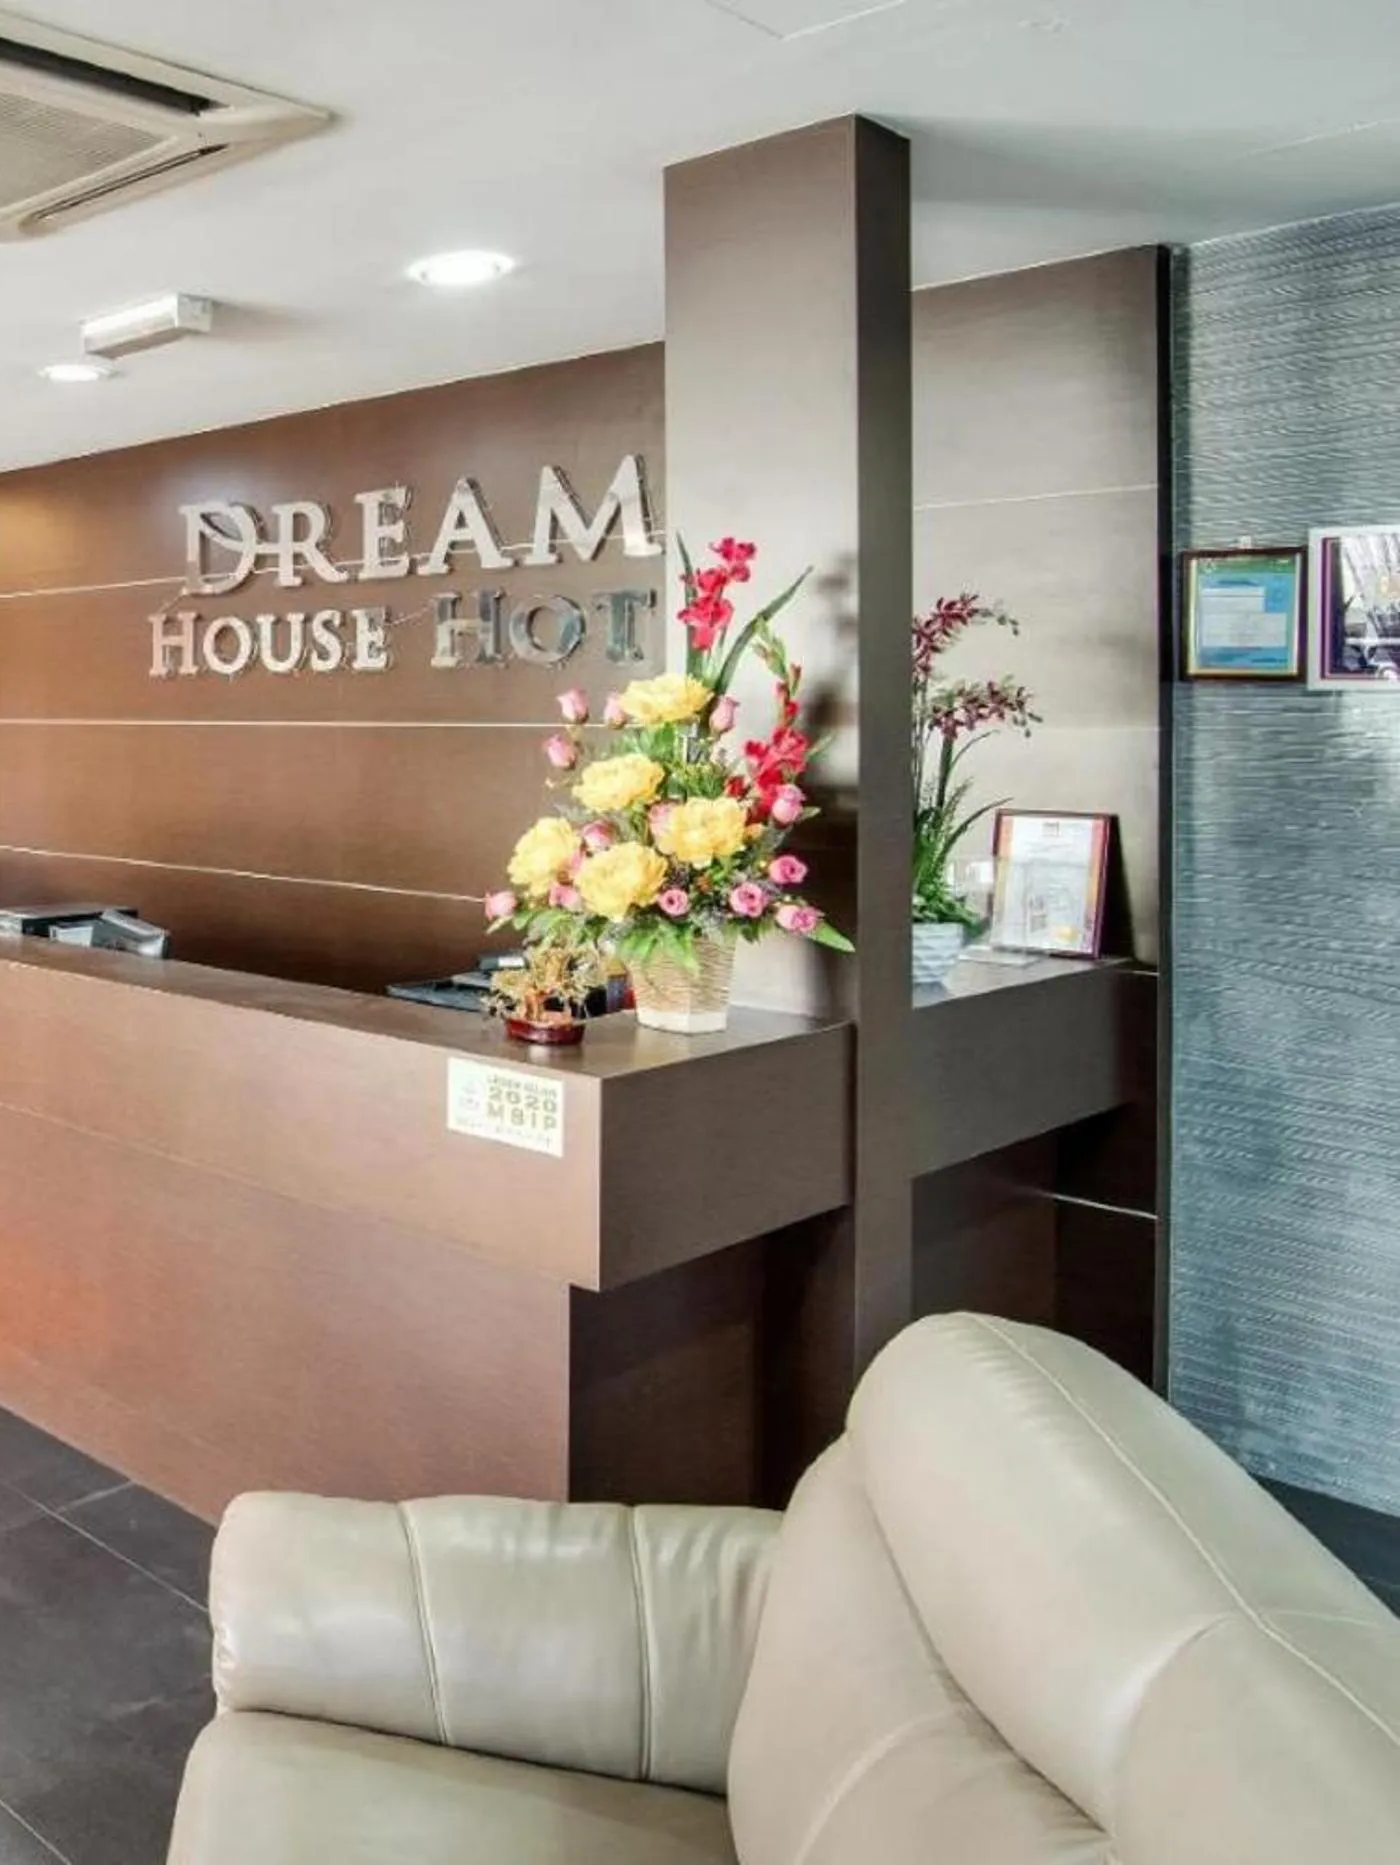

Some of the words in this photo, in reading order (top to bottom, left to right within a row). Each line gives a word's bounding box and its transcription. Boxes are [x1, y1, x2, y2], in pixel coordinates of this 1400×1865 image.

[177, 453, 664, 596] DREAM
[148, 605, 395, 676] HOUSE
[488, 1085, 557, 1114] 2020
